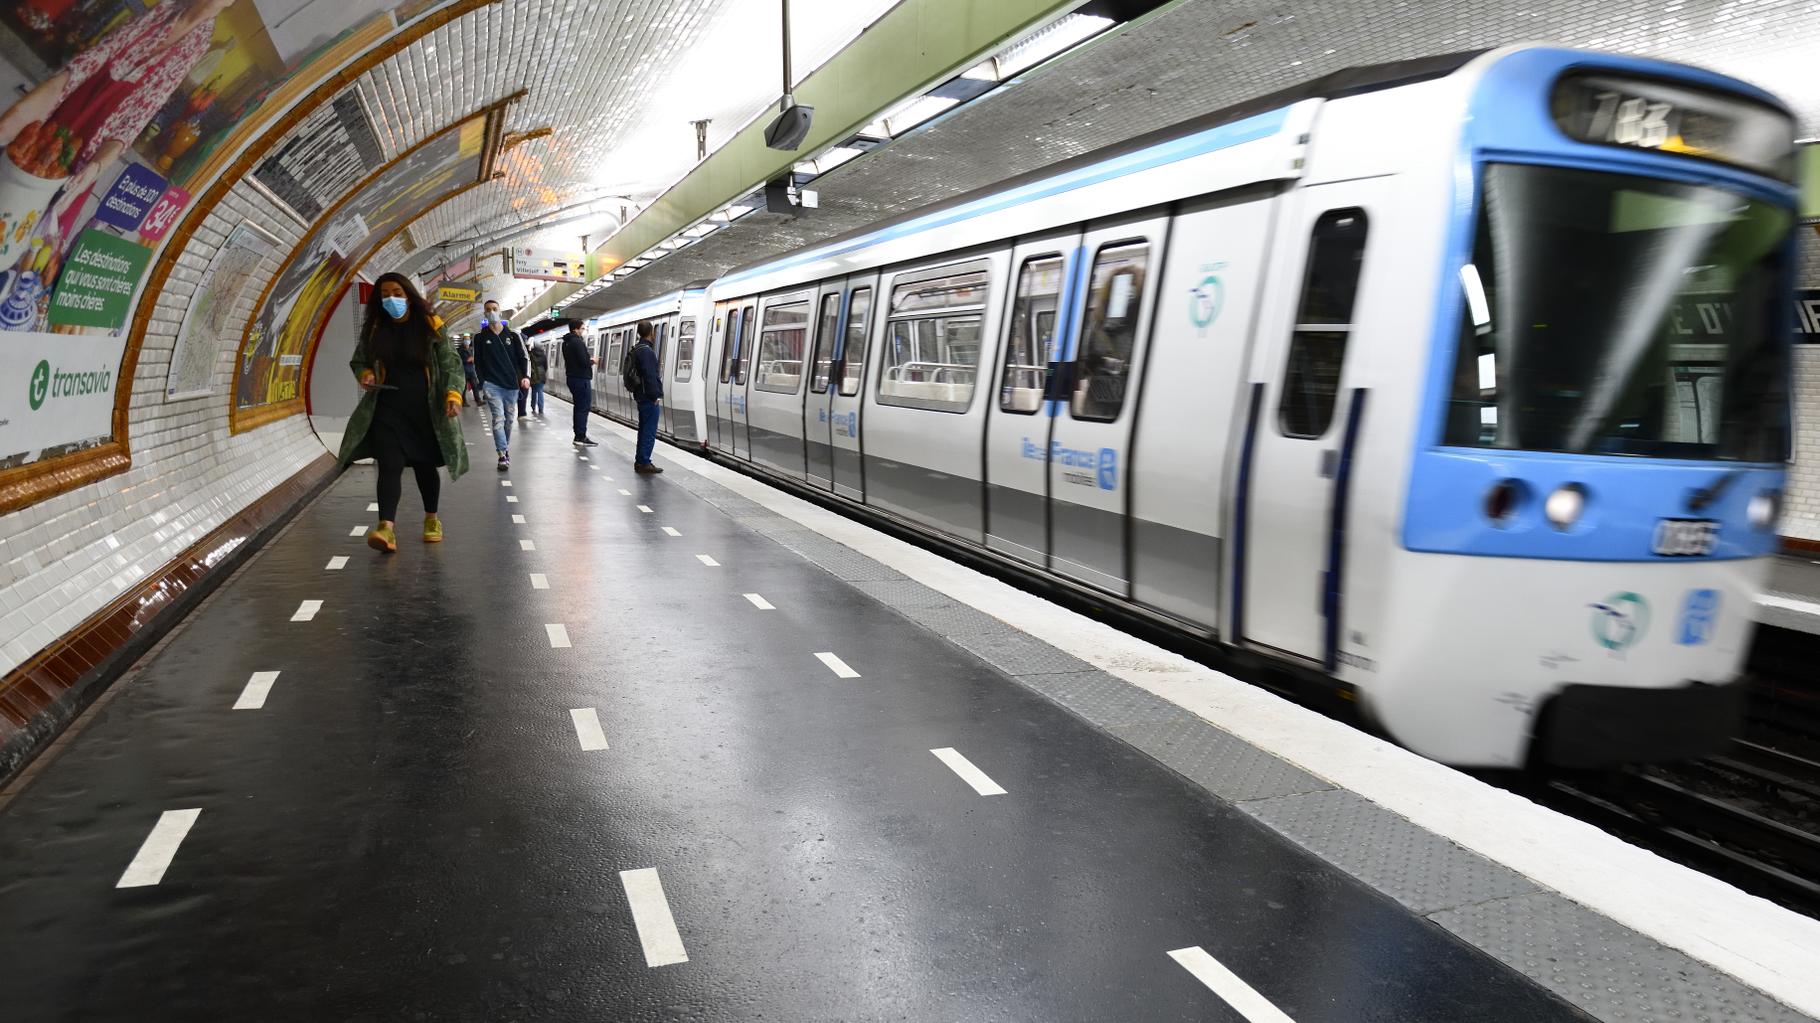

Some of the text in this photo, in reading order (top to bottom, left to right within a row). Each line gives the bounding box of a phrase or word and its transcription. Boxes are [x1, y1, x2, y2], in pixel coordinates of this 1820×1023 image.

[118, 175, 131, 191] Et
[105, 193, 142, 218] destinations
[74, 243, 132, 274] Les destinations
[65, 267, 133, 295] qui vous sont chères
[56, 288, 105, 311] moins chères
[442, 290, 471, 299] Alarme
[52, 363, 111, 398] transavia
